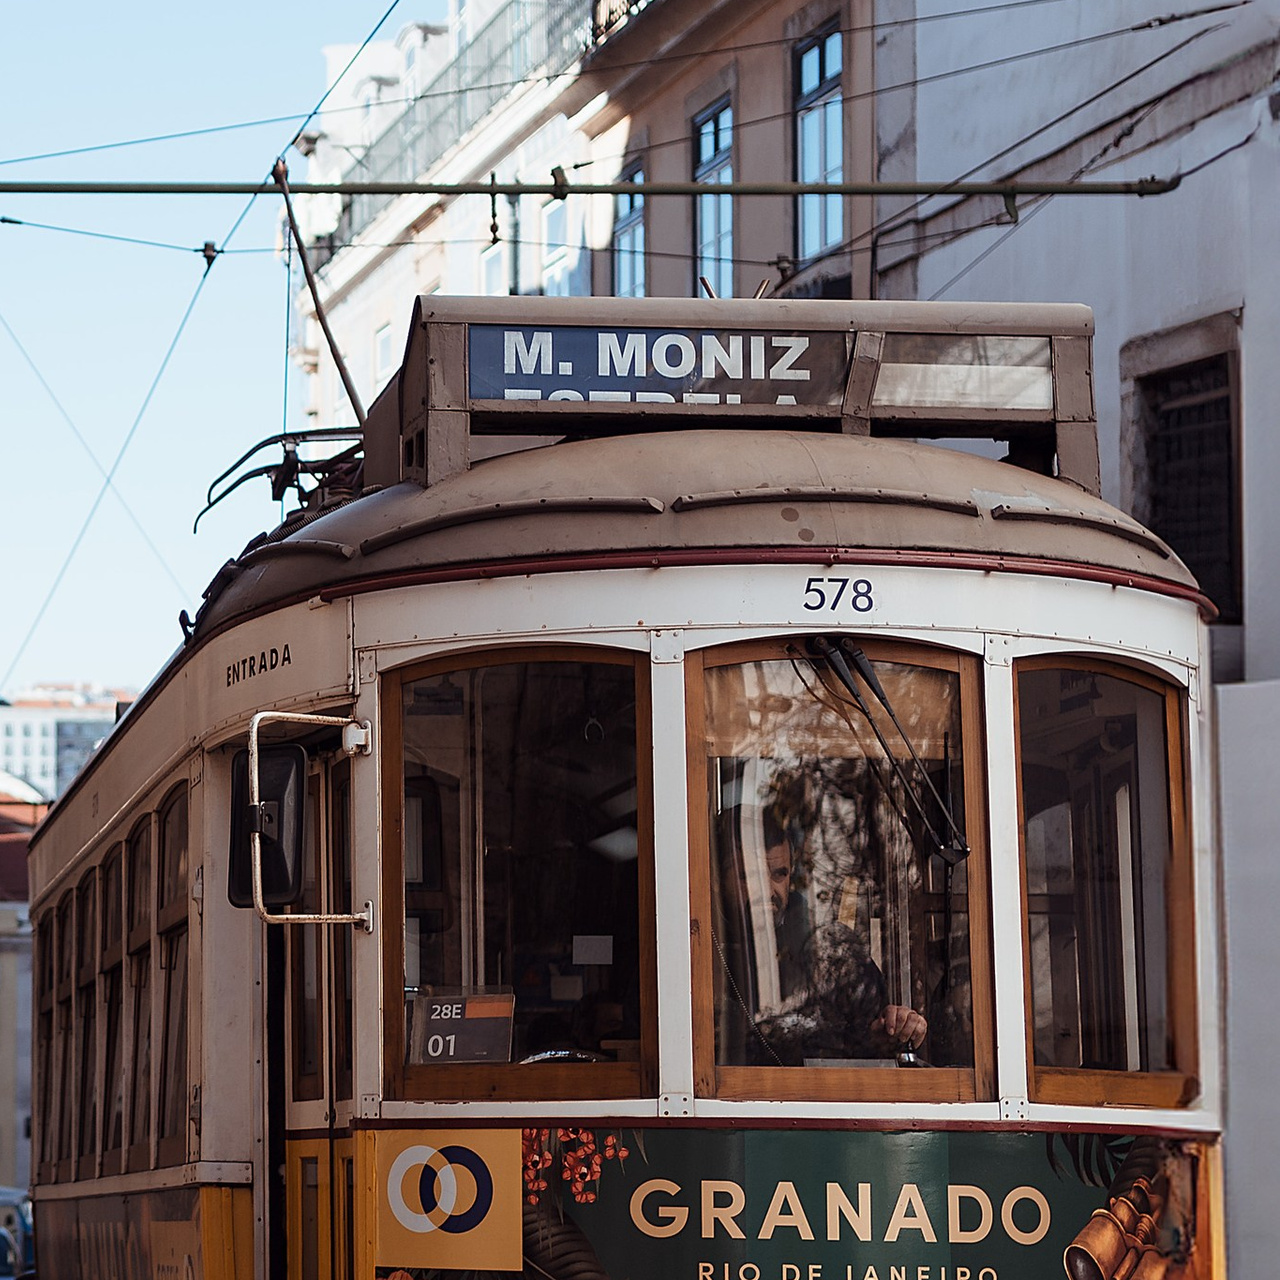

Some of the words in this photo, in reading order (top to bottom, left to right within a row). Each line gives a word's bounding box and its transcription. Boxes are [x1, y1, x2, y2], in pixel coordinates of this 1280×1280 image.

[503, 330, 573, 375] M.
[597, 332, 811, 381] MONIZ
[802, 576, 874, 613] 578
[226, 643, 292, 688] ENTRADA
[430, 1003, 462, 1020] 28E
[427, 1034, 456, 1058] 01
[629, 1178, 1052, 1246] GRANADO
